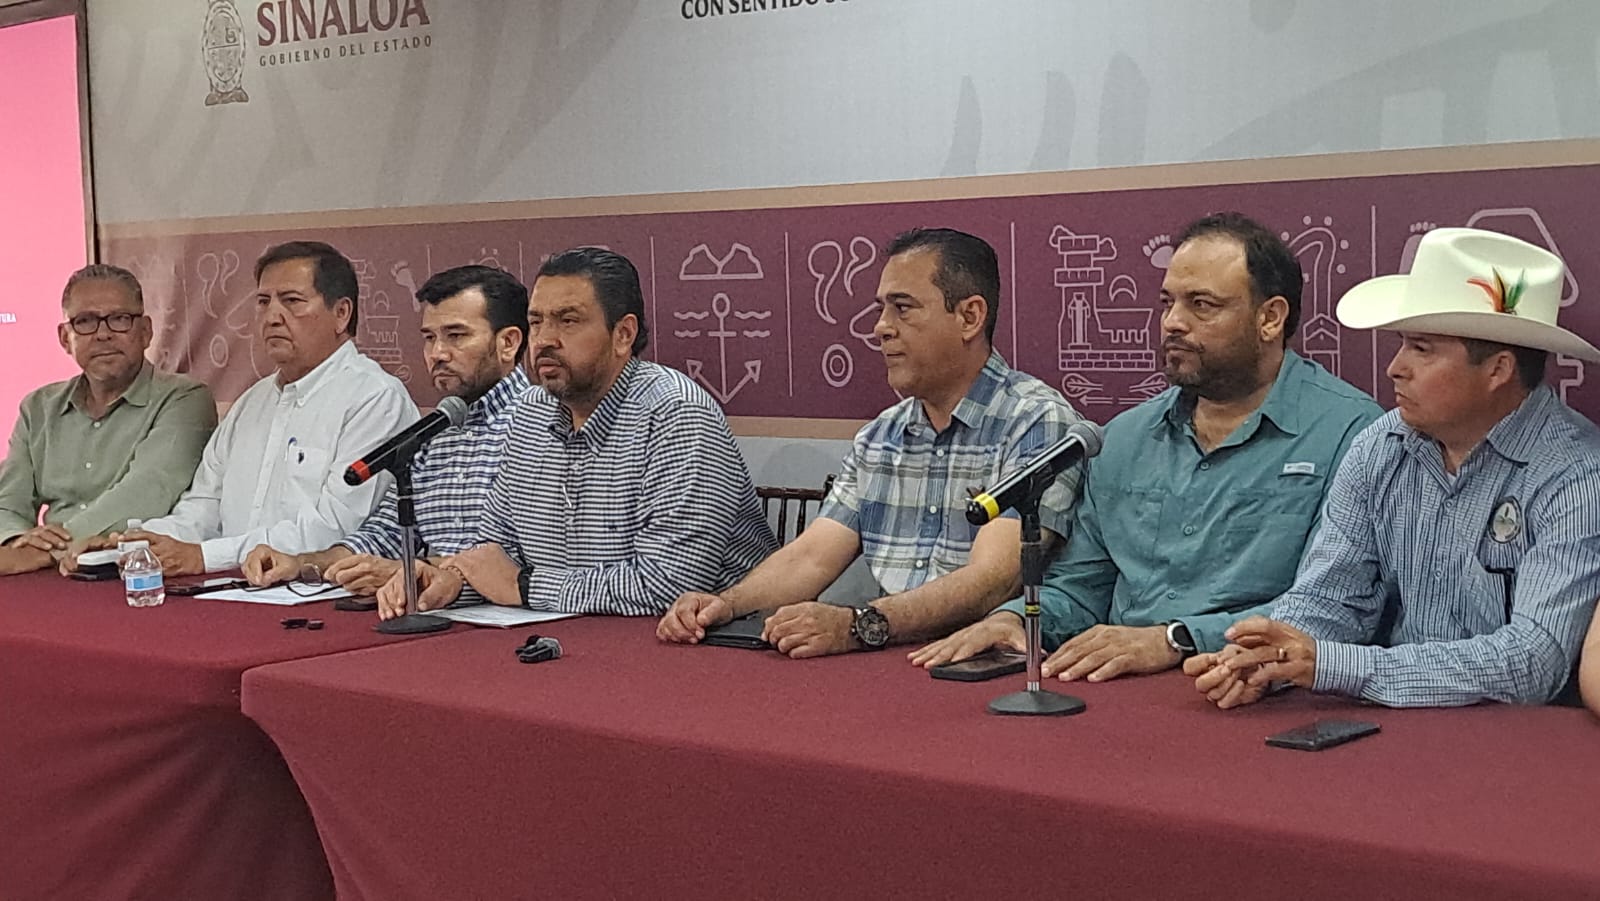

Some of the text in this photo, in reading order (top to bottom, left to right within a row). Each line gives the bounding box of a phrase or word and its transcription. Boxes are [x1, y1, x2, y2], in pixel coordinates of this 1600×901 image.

[257, 0, 431, 47] SINALOA
[681, 0, 819, 19] CON SENT
[259, 35, 432, 67] GOBIERNO DEL ESTADO
